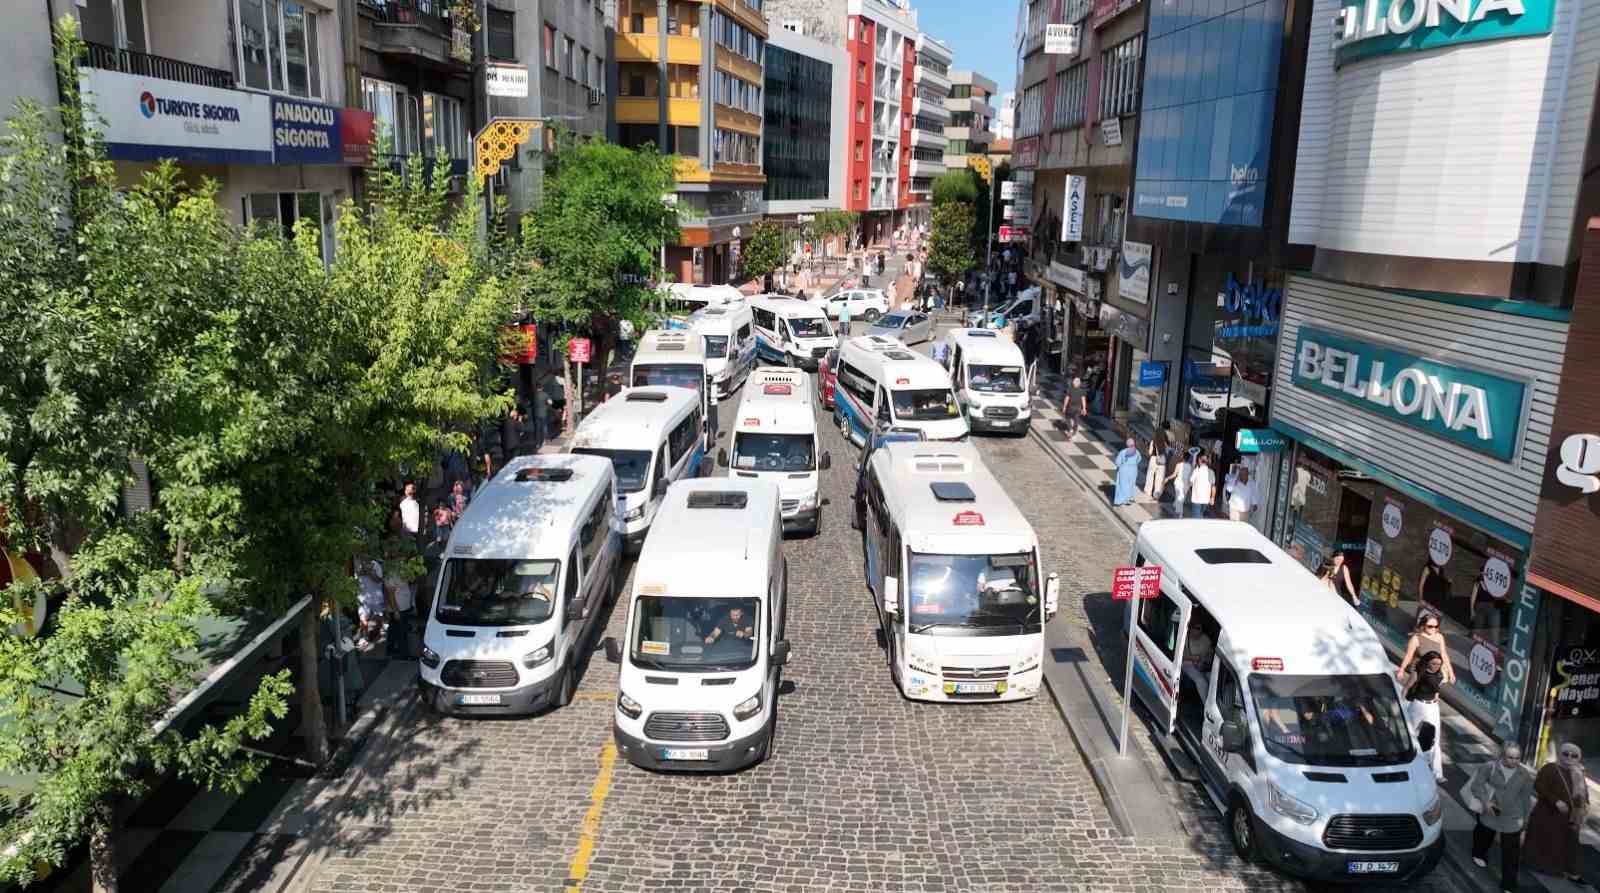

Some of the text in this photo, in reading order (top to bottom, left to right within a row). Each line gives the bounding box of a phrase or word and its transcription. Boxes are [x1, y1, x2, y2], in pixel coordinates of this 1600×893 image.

[275, 102, 334, 126] ANADOLU
[275, 123, 330, 148] SİGORTA
[1299, 340, 1493, 440] BELLONA
